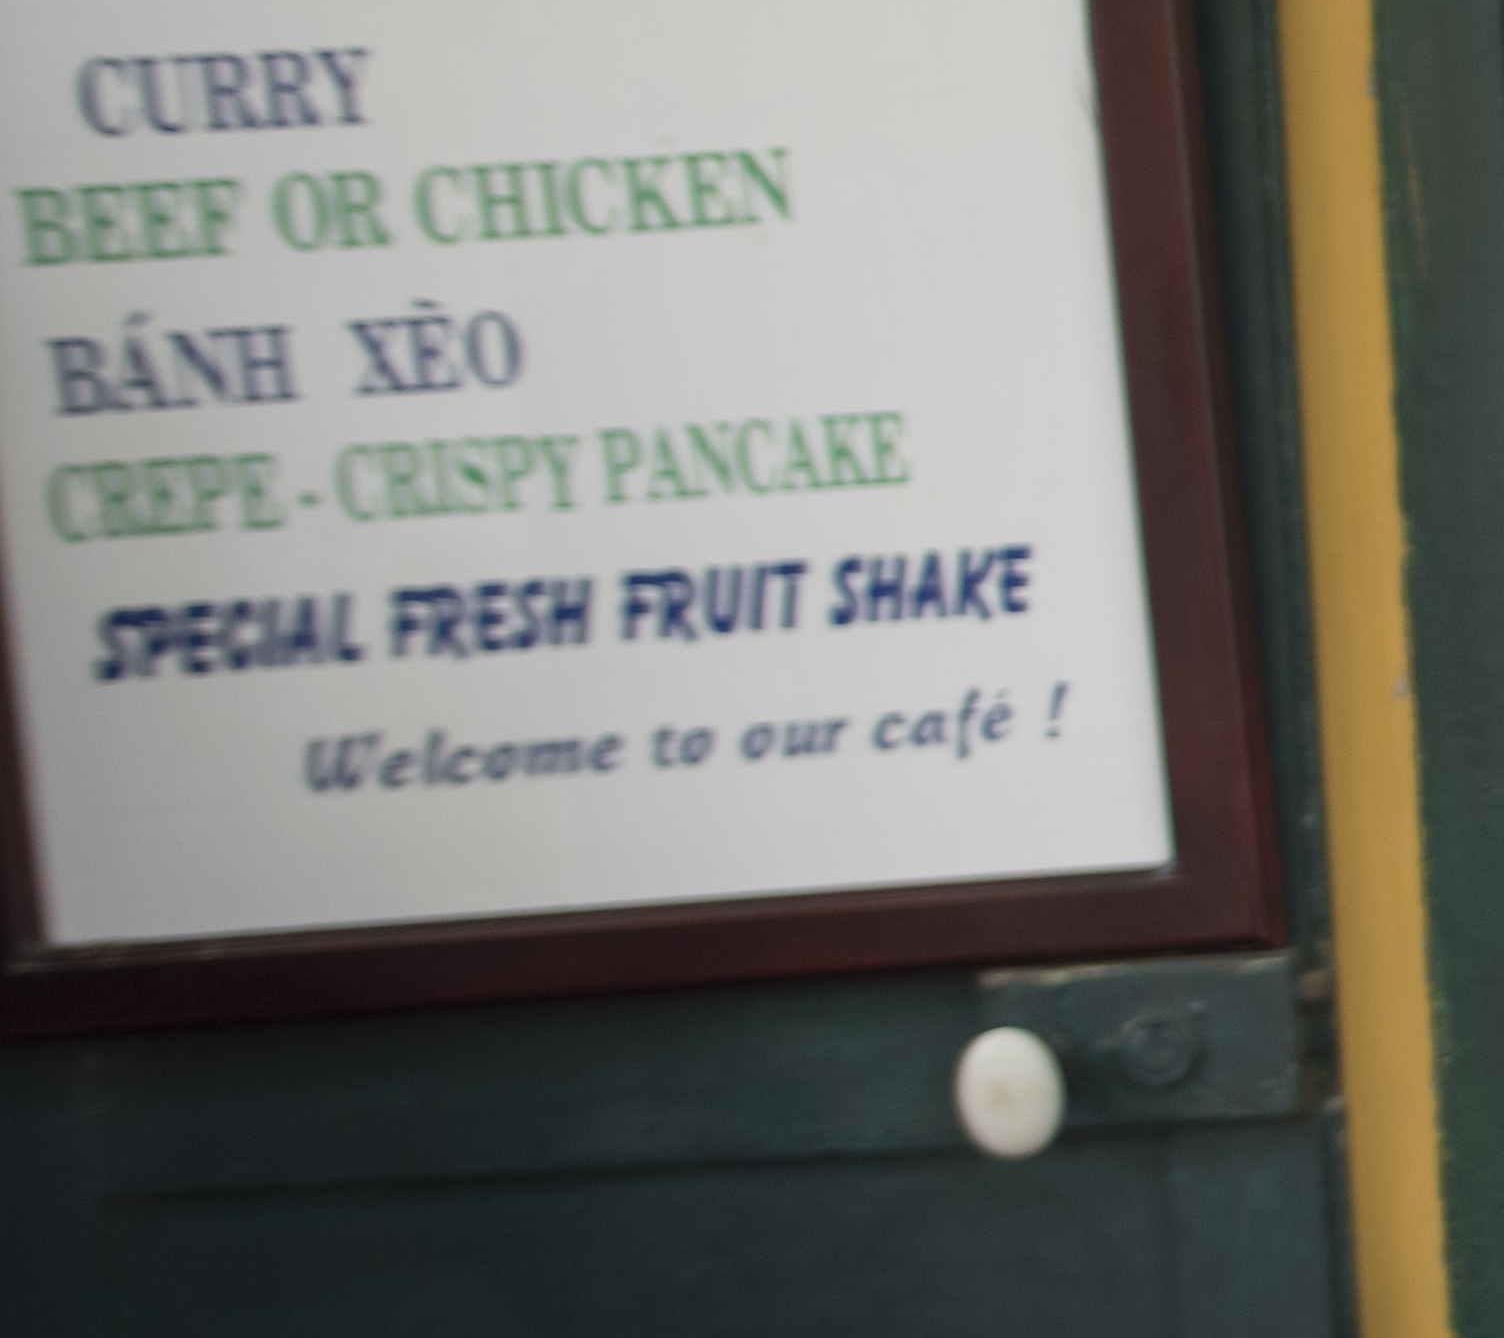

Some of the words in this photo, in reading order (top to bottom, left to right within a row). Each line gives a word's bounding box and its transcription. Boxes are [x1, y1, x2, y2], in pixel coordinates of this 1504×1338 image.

[74, 48, 370, 137] CURRY
[15, 178, 241, 266] BEEF
[270, 171, 393, 251] OR
[412, 148, 793, 245] CHICKEN
[45, 313, 299, 418] BÁNH
[44, 454, 283, 543] CREPE
[333, 436, 580, 523] CRISPY
[598, 412, 911, 505] PANCAKE
[94, 594, 365, 681] SPECIAL
[388, 578, 594, 658] FRESH
[620, 561, 809, 642] FRUIT
[828, 545, 1033, 627] SHAKE
[303, 727, 624, 795] Welcome
[649, 725, 717, 770] to
[739, 717, 849, 763] our
[870, 687, 1014, 760] café
